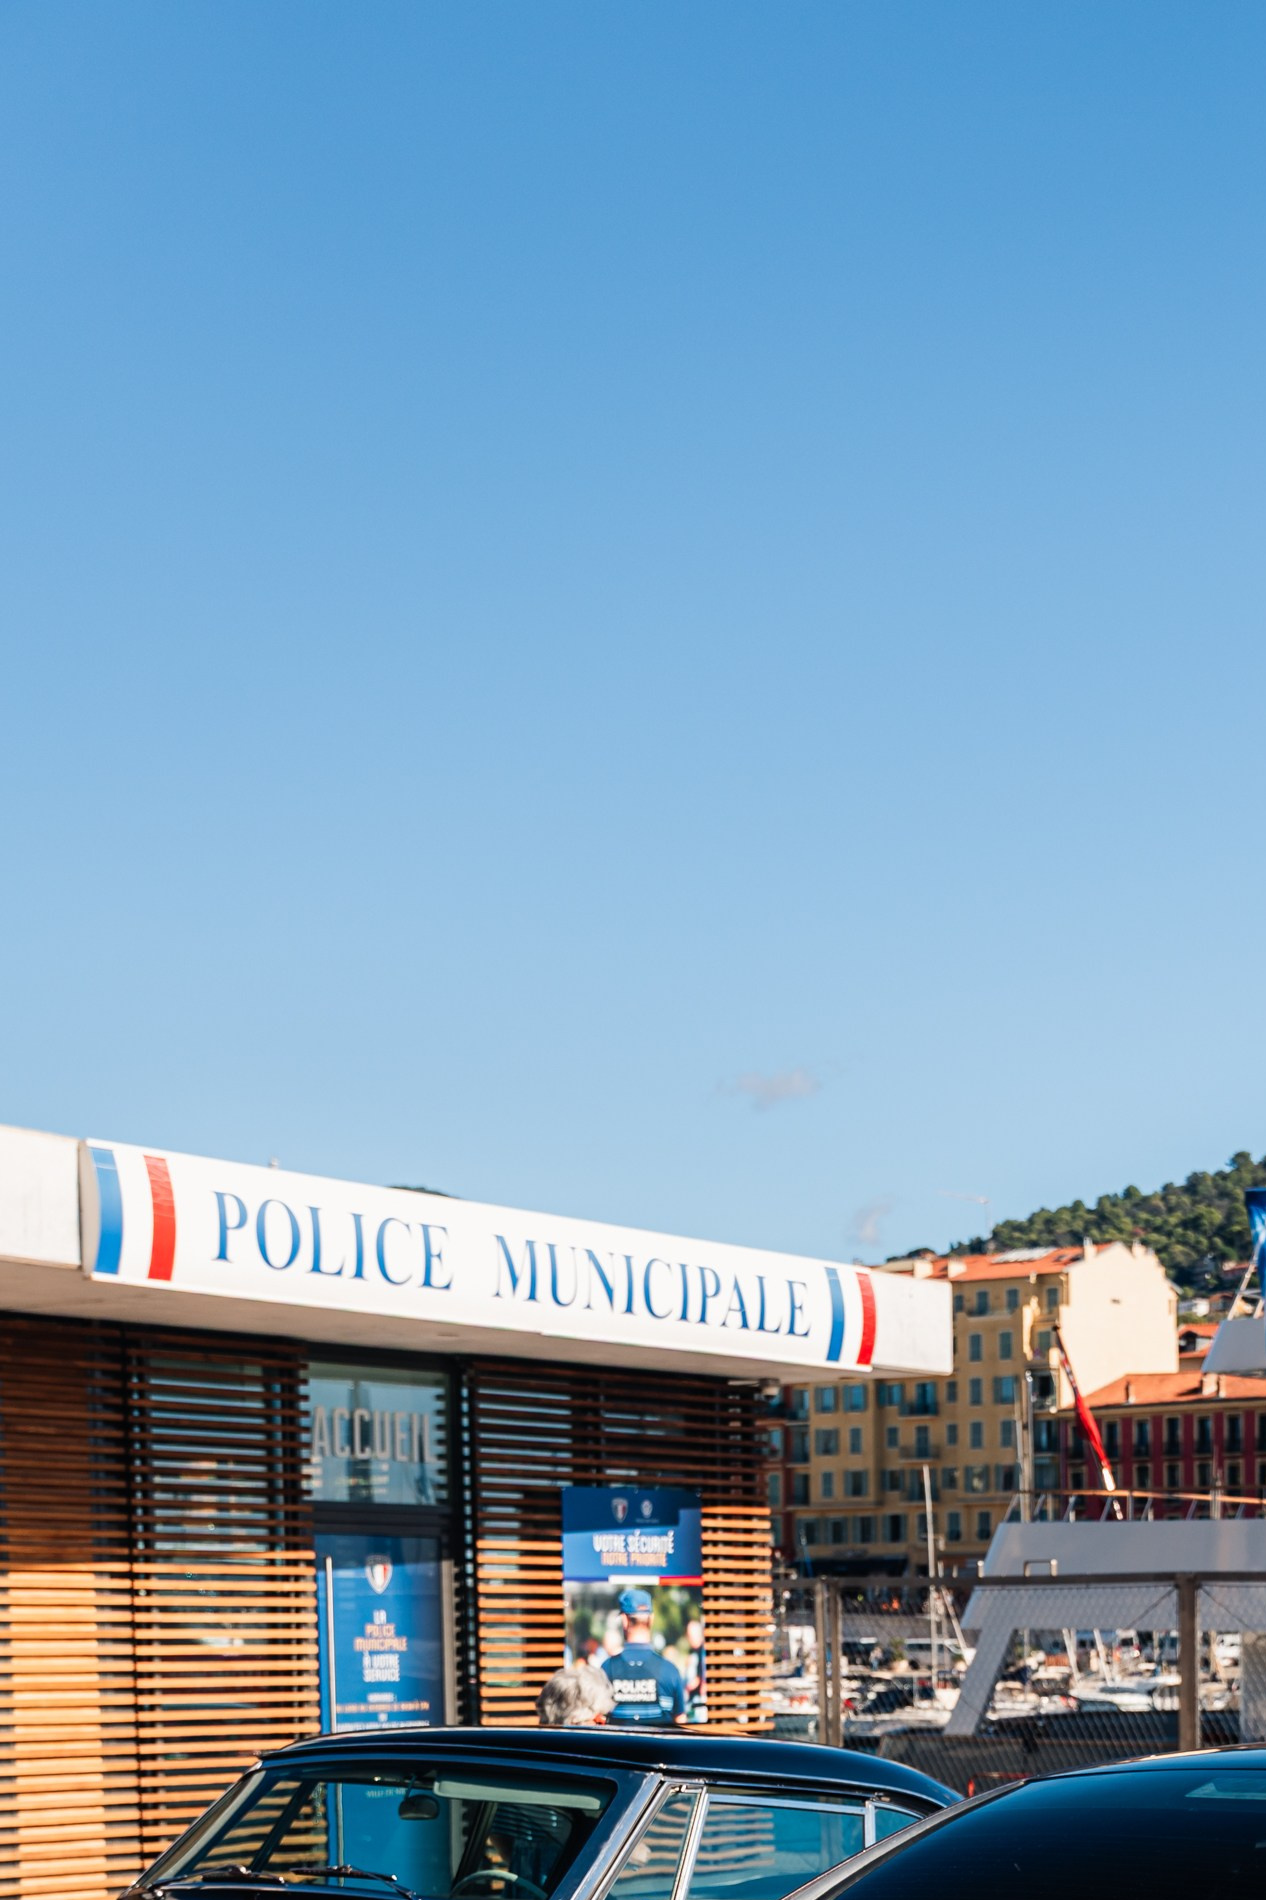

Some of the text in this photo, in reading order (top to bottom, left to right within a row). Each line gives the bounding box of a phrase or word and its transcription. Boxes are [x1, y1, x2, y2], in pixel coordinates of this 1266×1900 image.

[212, 1190, 813, 1340] POLICE MUNICIPALE
[311, 1404, 439, 1463] ACCUEIL
[353, 1636, 408, 1651] MUNICIPALE
[365, 1623, 396, 1638] POLICE
